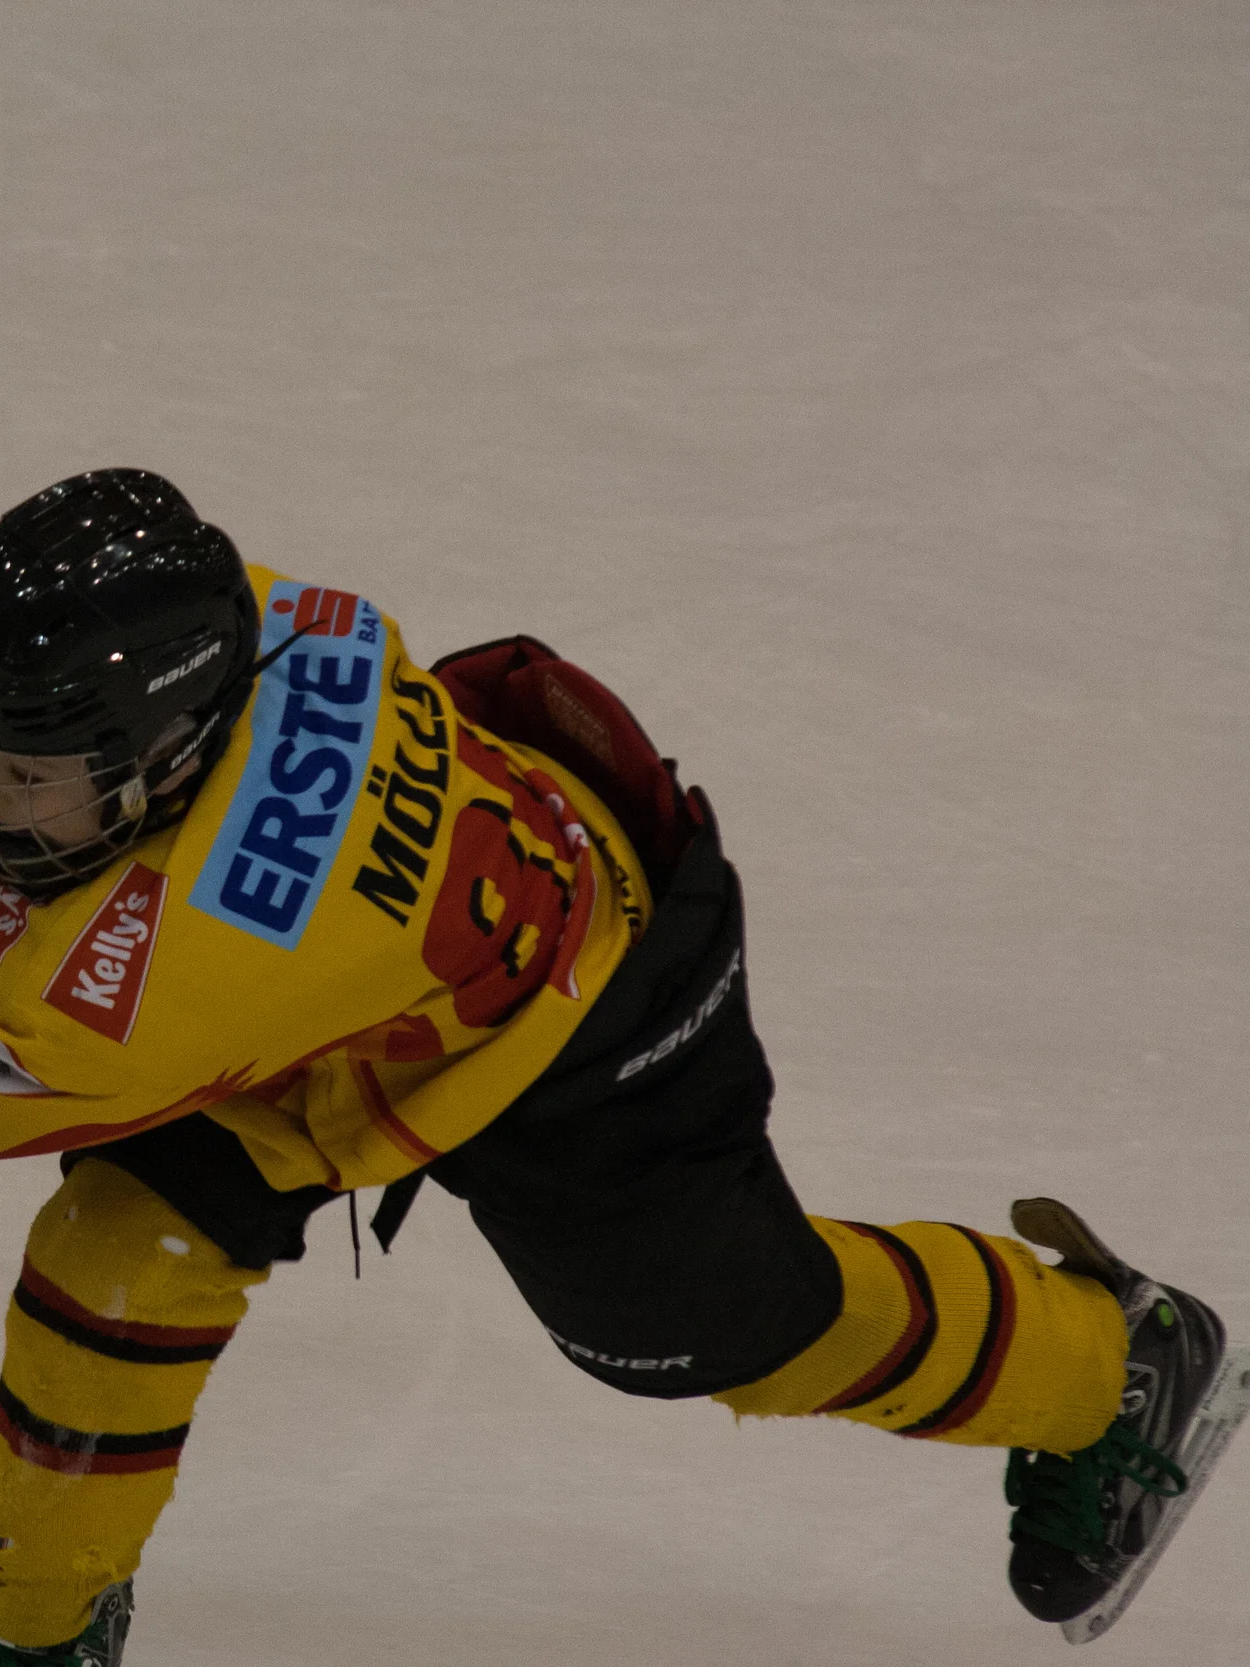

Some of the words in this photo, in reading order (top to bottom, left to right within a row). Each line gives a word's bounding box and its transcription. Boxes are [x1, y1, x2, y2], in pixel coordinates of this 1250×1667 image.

[147, 640, 221, 694] BAUER
[219, 653, 372, 933] ERSTE
[71, 891, 149, 1010] Kelly's
[616, 947, 741, 1082] BAUER
